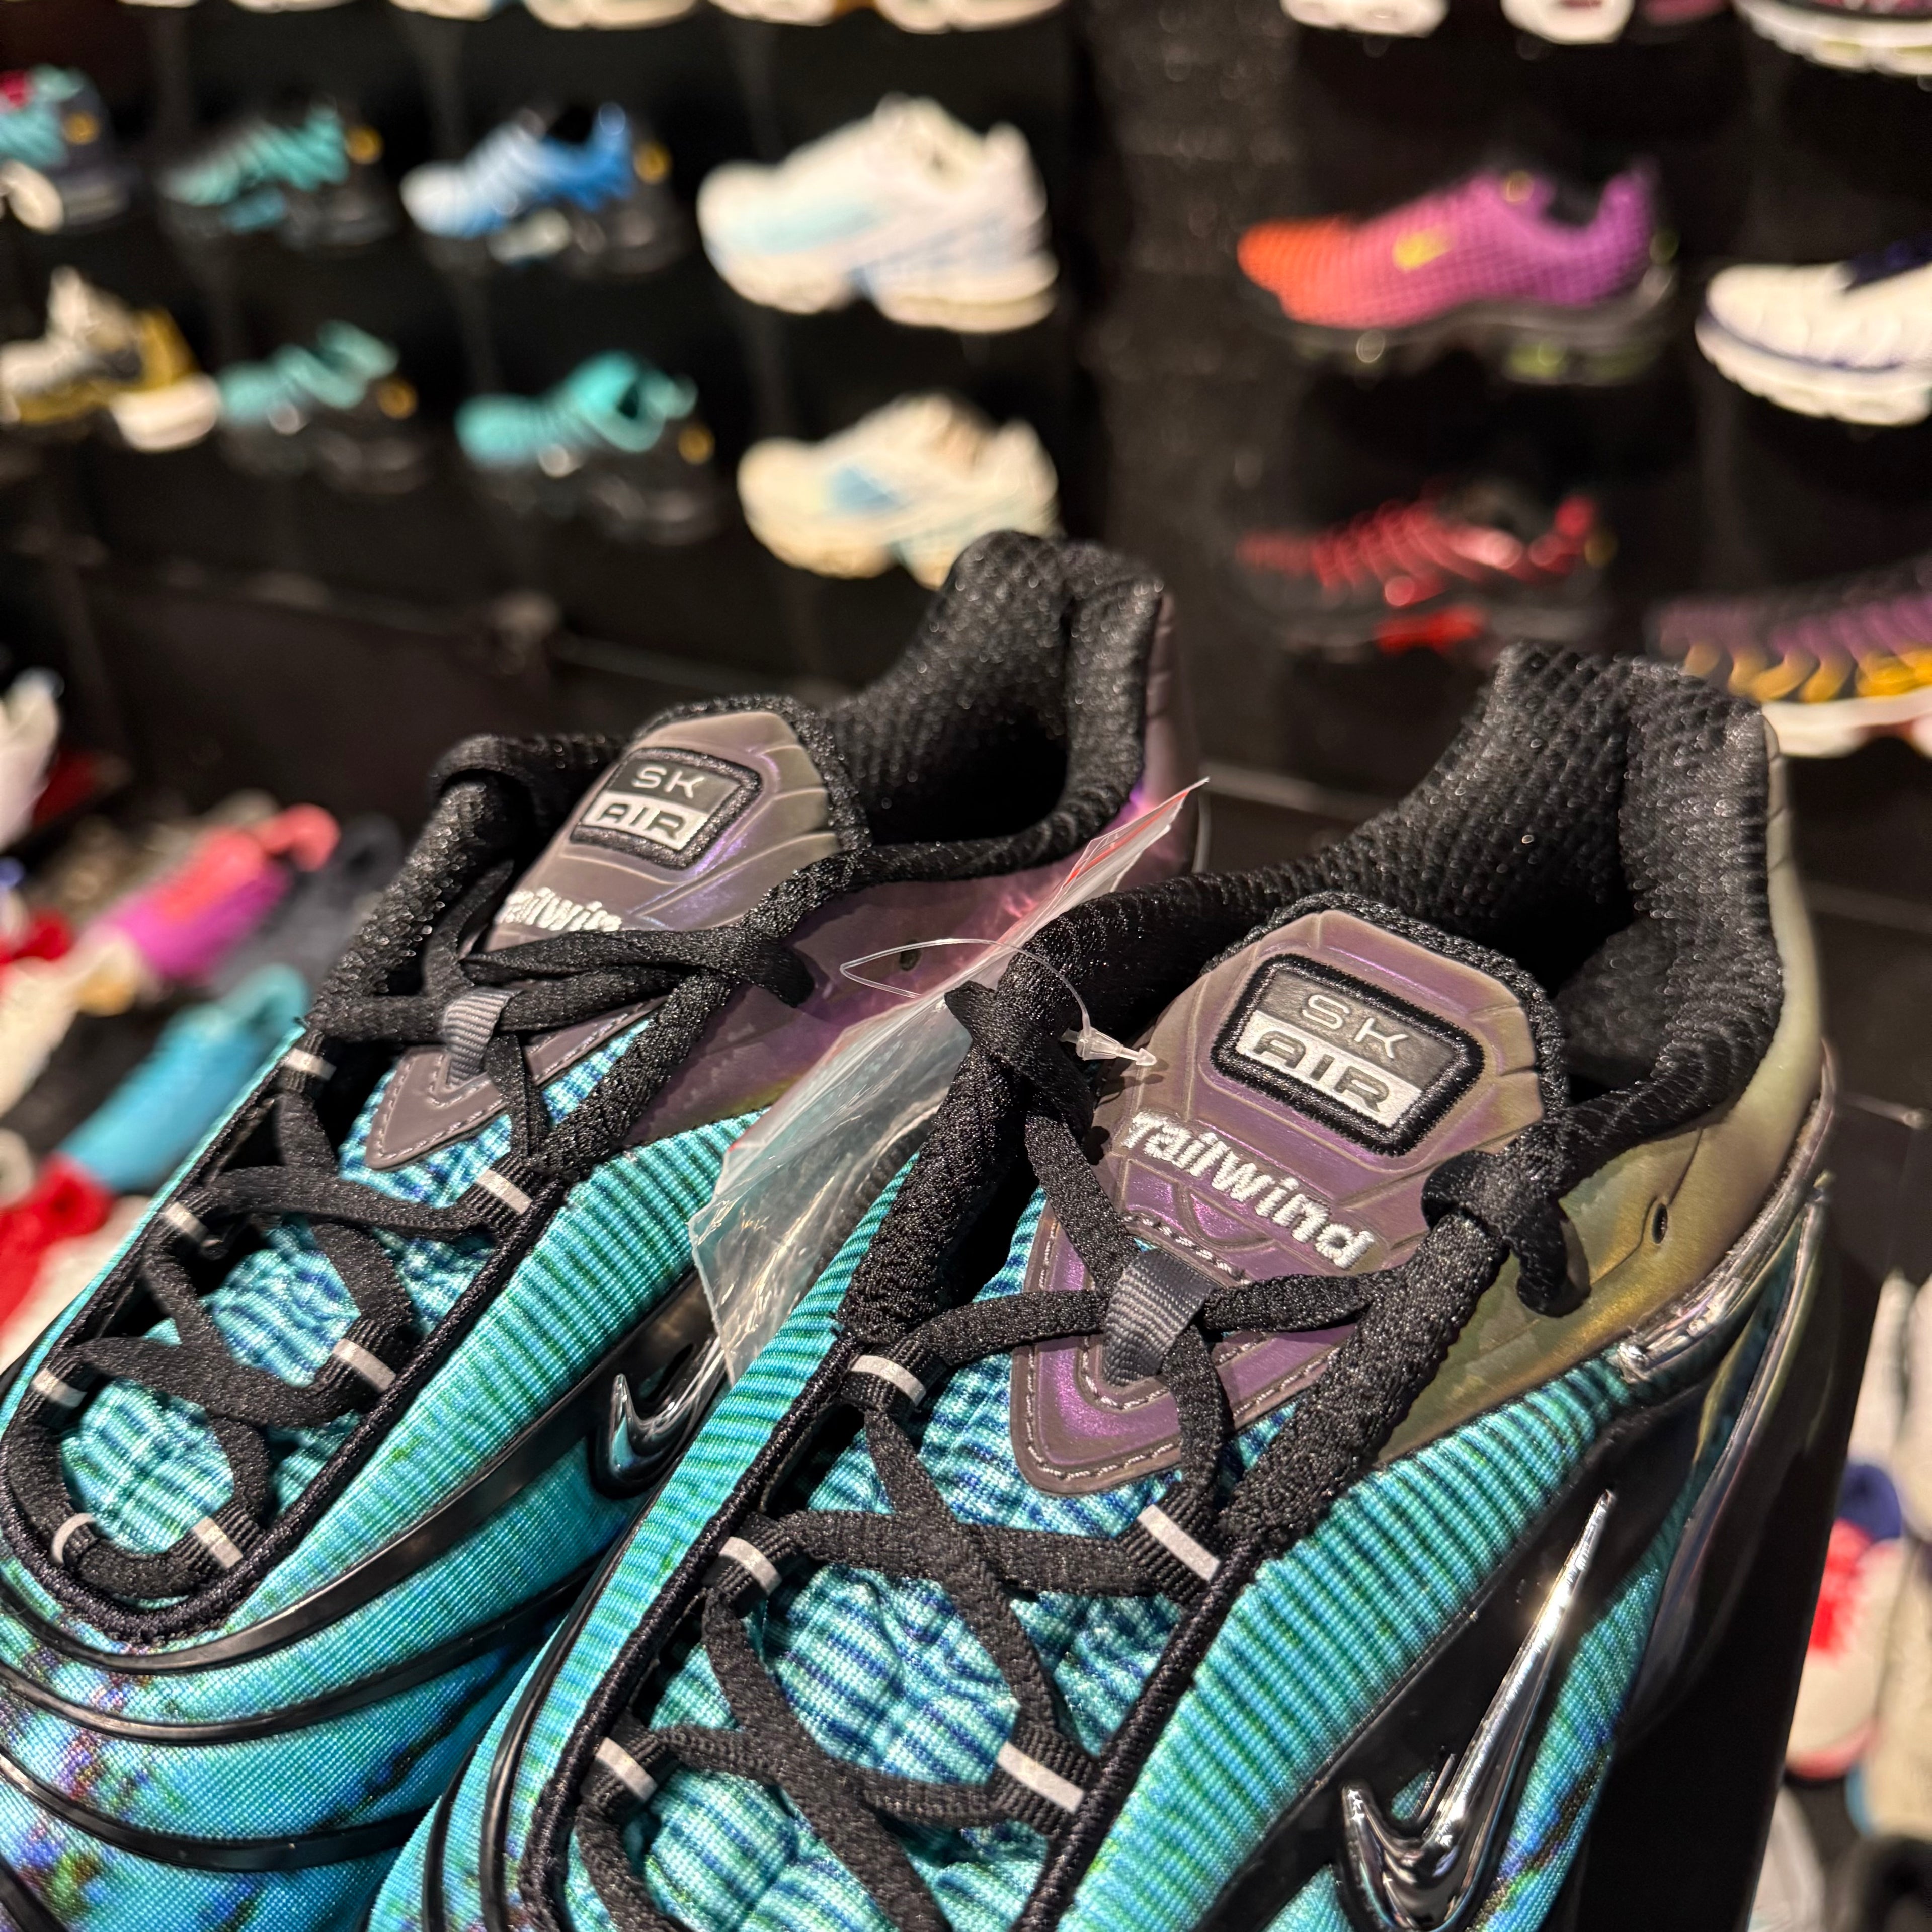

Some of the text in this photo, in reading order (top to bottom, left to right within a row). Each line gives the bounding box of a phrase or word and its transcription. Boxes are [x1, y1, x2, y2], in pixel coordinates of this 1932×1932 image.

[631, 765, 704, 799] SK
[596, 803, 686, 839] AIR
[1302, 994, 1409, 1059] SK
[1253, 1030, 1389, 1113] AIR
